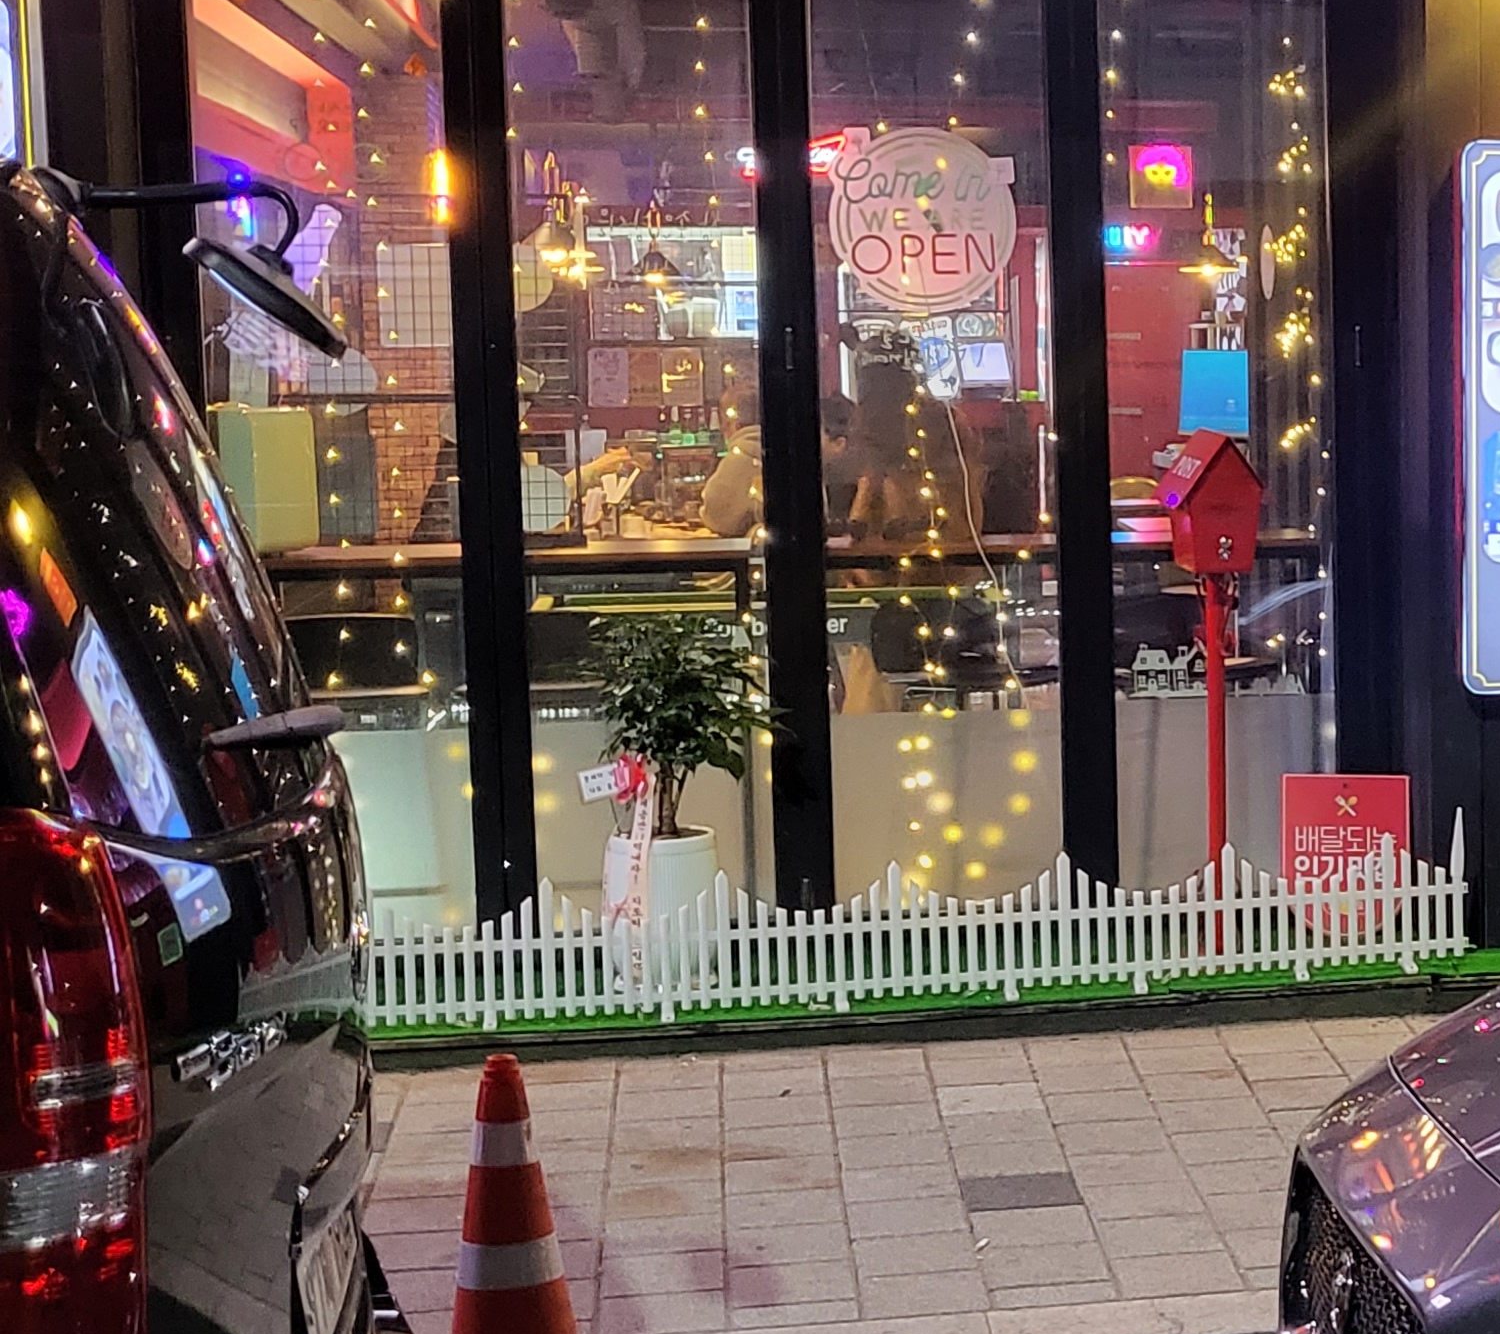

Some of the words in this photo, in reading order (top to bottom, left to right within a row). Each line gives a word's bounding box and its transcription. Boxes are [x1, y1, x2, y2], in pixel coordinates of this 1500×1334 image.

[834, 156, 944, 204] Come
[858, 208, 911, 232] WE
[850, 232, 997, 275] OPEN
